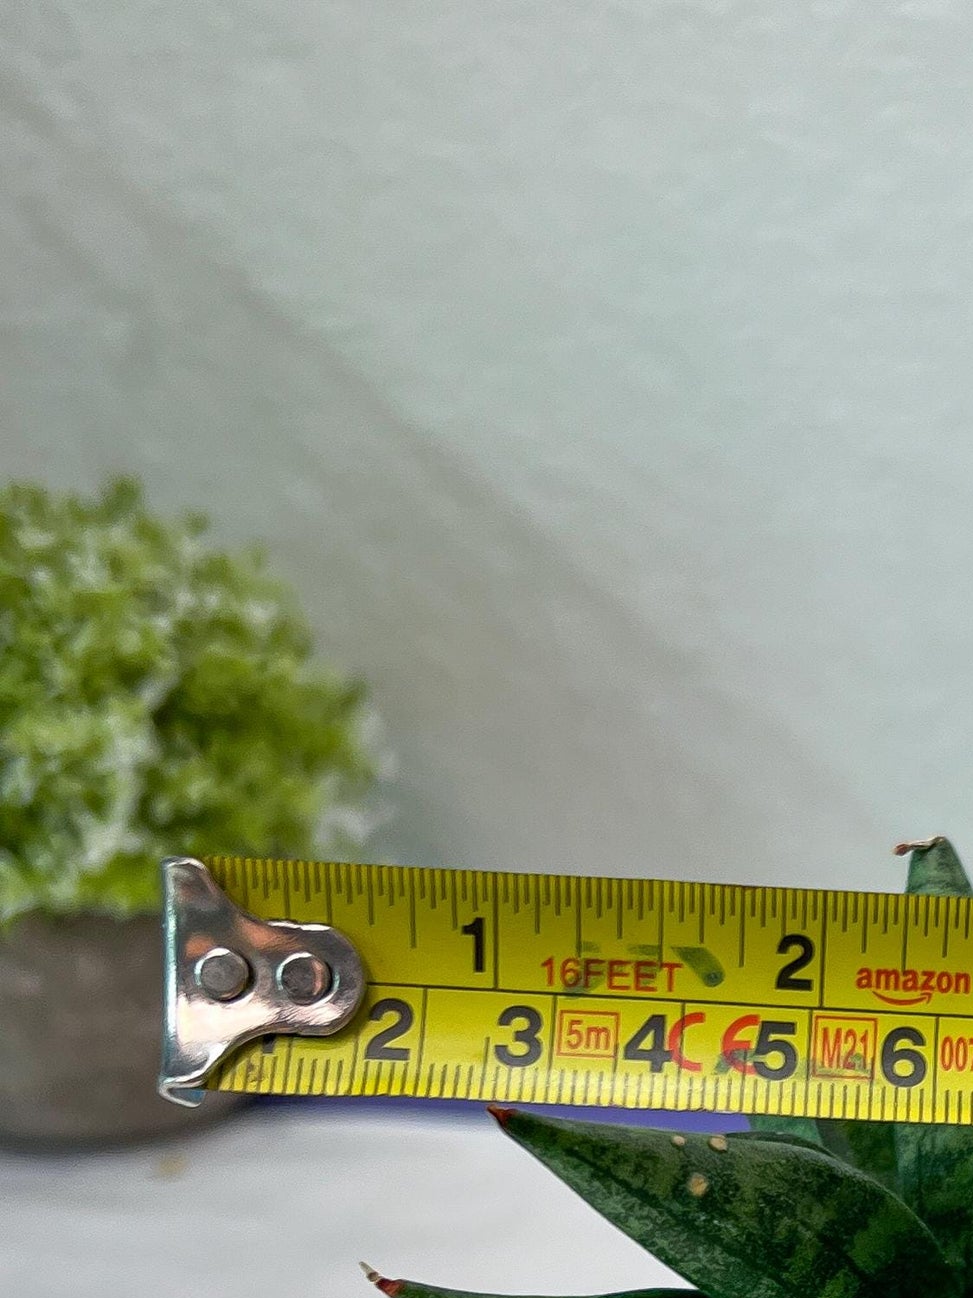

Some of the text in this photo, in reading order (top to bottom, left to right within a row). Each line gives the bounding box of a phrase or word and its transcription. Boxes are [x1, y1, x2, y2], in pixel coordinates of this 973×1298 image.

[461, 917, 485, 973] 1
[775, 933, 814, 991] 2
[855, 967, 971, 994] amazon
[364, 998, 414, 1061] 2
[494, 1005, 542, 1068] 3
[566, 1019, 611, 1051] 5m
[624, 1014, 672, 1073] 4
[755, 1020, 797, 1080] 5
[821, 1026, 869, 1070] M21
[880, 1026, 927, 1088] 6
